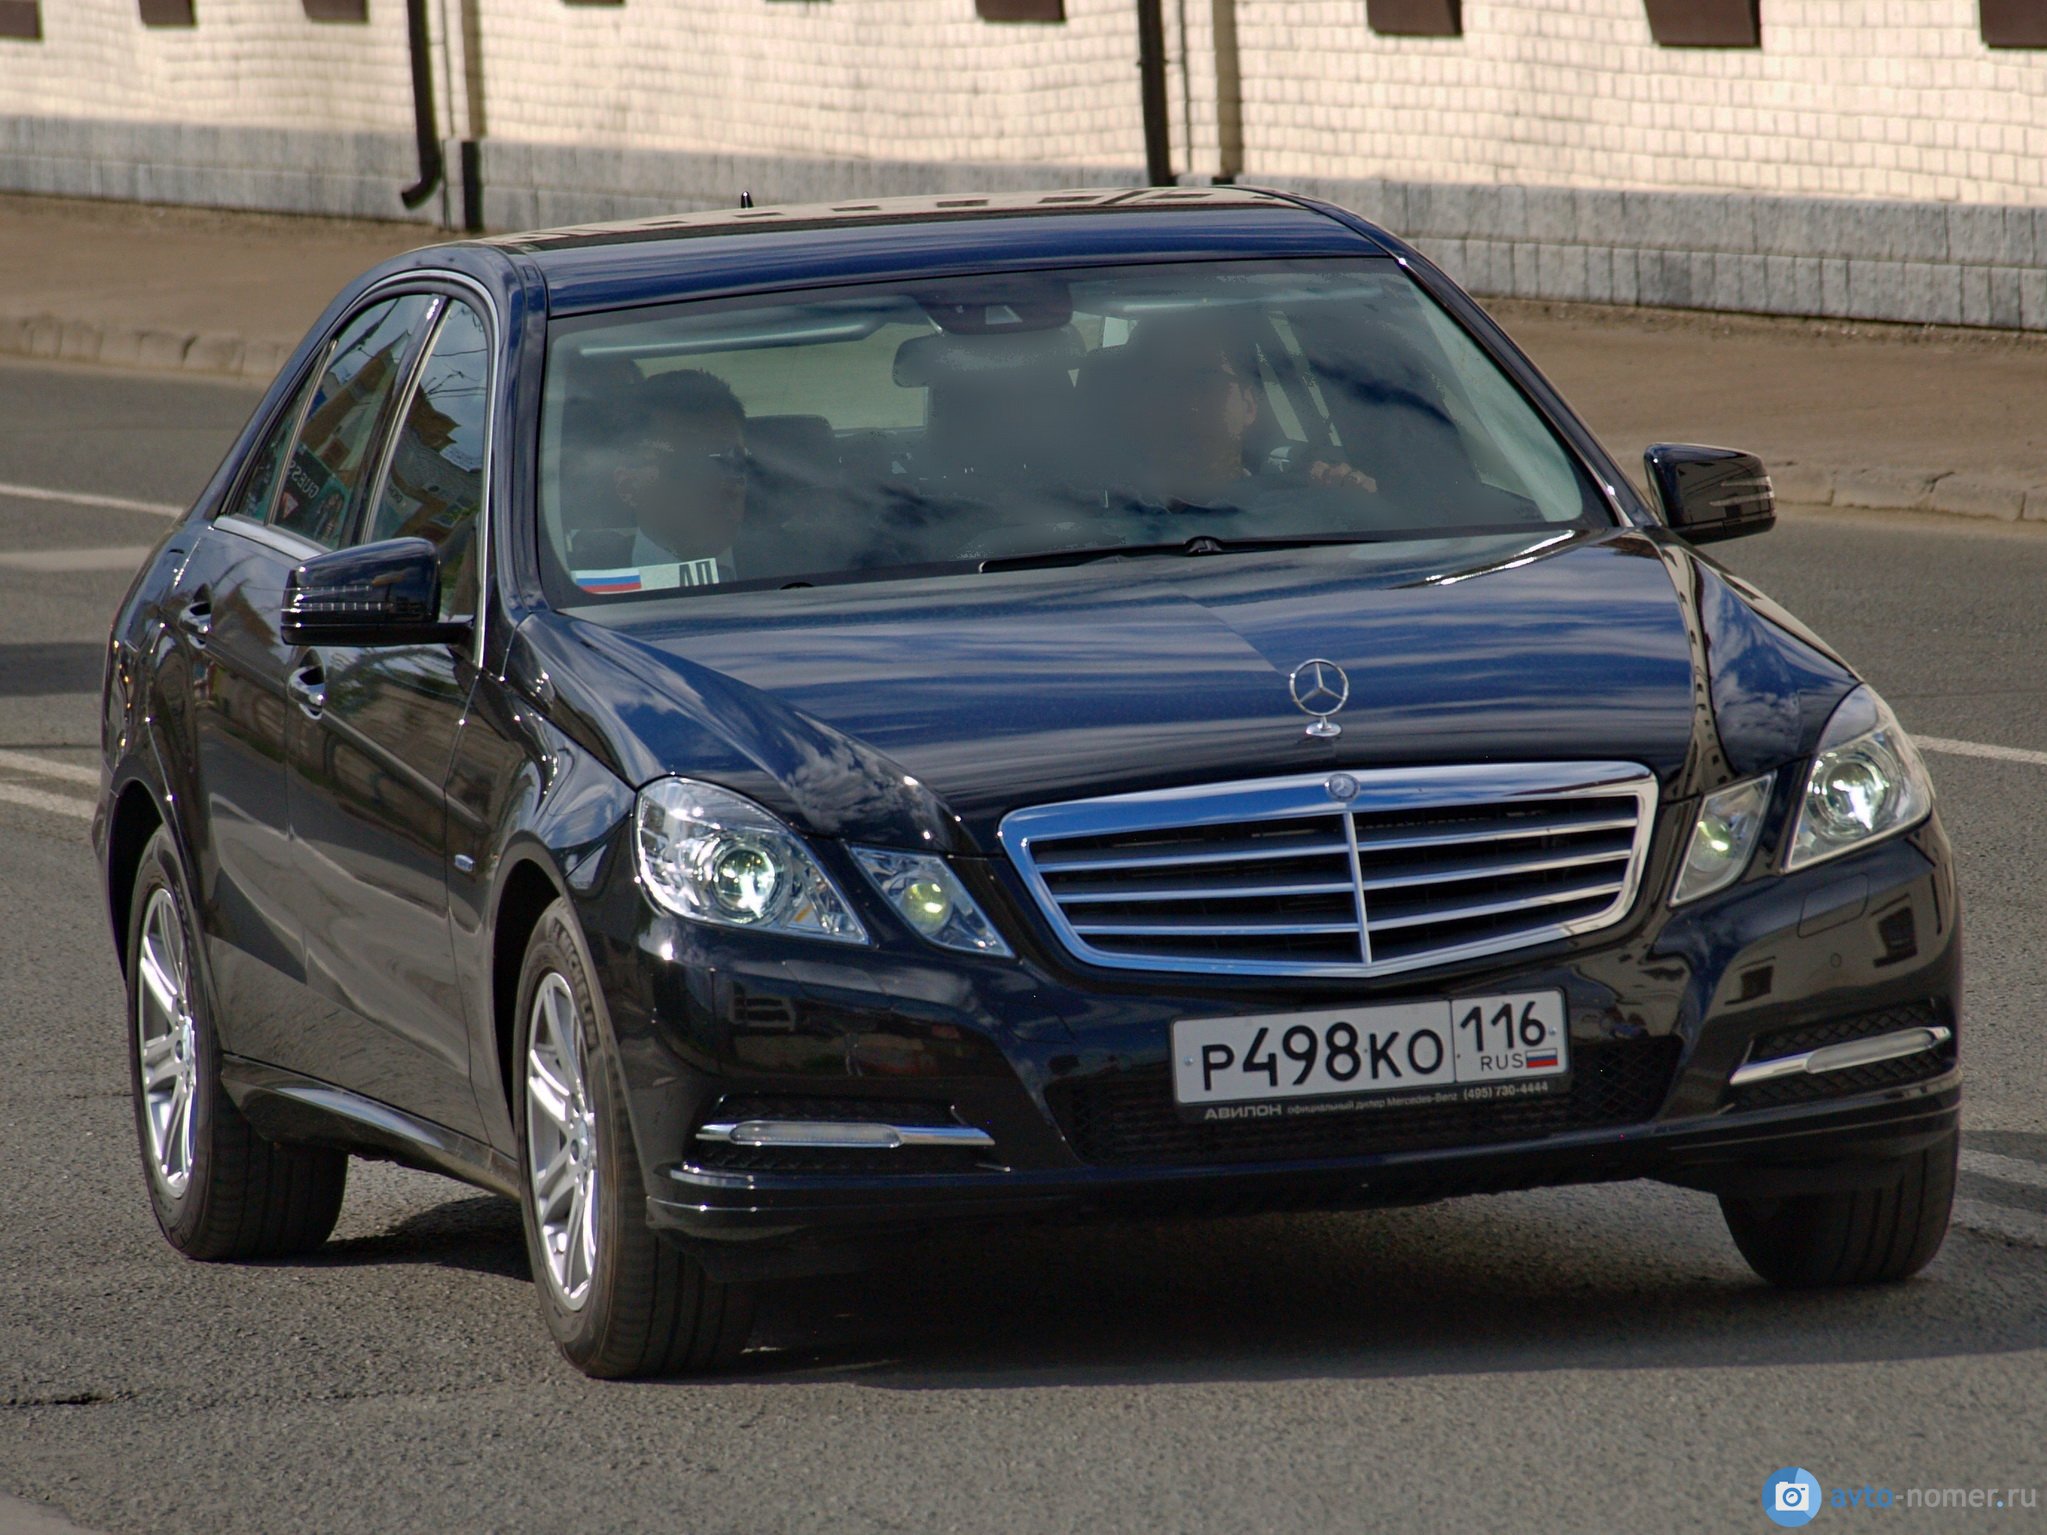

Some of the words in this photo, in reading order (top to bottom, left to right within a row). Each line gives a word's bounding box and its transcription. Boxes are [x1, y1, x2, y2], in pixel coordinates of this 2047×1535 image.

[1460, 1001, 1546, 1052] 116
[1481, 1053, 1524, 1072] RUS
[1204, 1104, 1281, 1121] АВИЛОН
[1463, 1086, 1492, 1101] (495)
[1495, 1080, 1547, 1097] 730-4444
